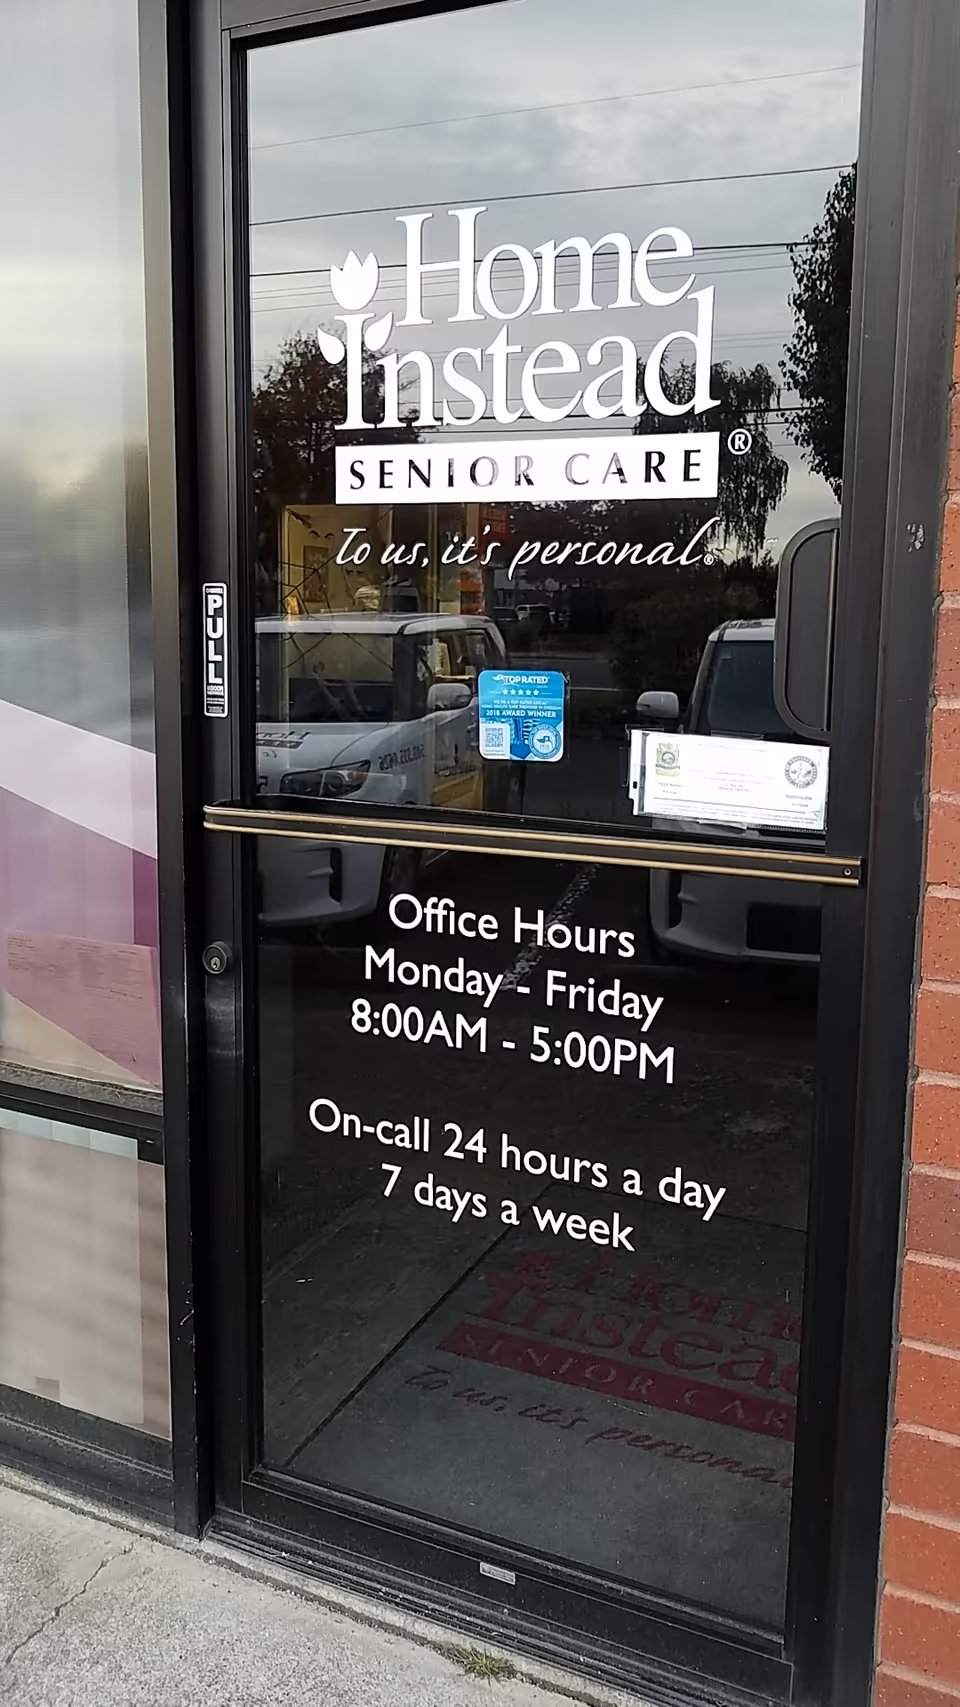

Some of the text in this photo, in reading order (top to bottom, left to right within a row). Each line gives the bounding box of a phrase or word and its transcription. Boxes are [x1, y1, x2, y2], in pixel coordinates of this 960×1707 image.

[395, 206, 696, 327] Home
[334, 285, 721, 431] Instead
[349, 448, 702, 490] SENIOR CARE
[336, 527, 371, 565] To
[380, 541, 429, 568] us,
[441, 524, 501, 565] it's
[206, 594, 224, 684] PULL
[504, 675, 549, 685] TOP RATED
[527, 710, 557, 718] WINNER
[389, 893, 635, 958] Office Hours
[364, 945, 503, 1008] Monday
[545, 970, 664, 1032] Friday
[351, 998, 488, 1053] 8:00AM
[530, 1025, 676, 1084] 5:00PM
[309, 1098, 727, 1222] On-call 24 hours a day
[381, 1163, 635, 1252] 7 days a week
